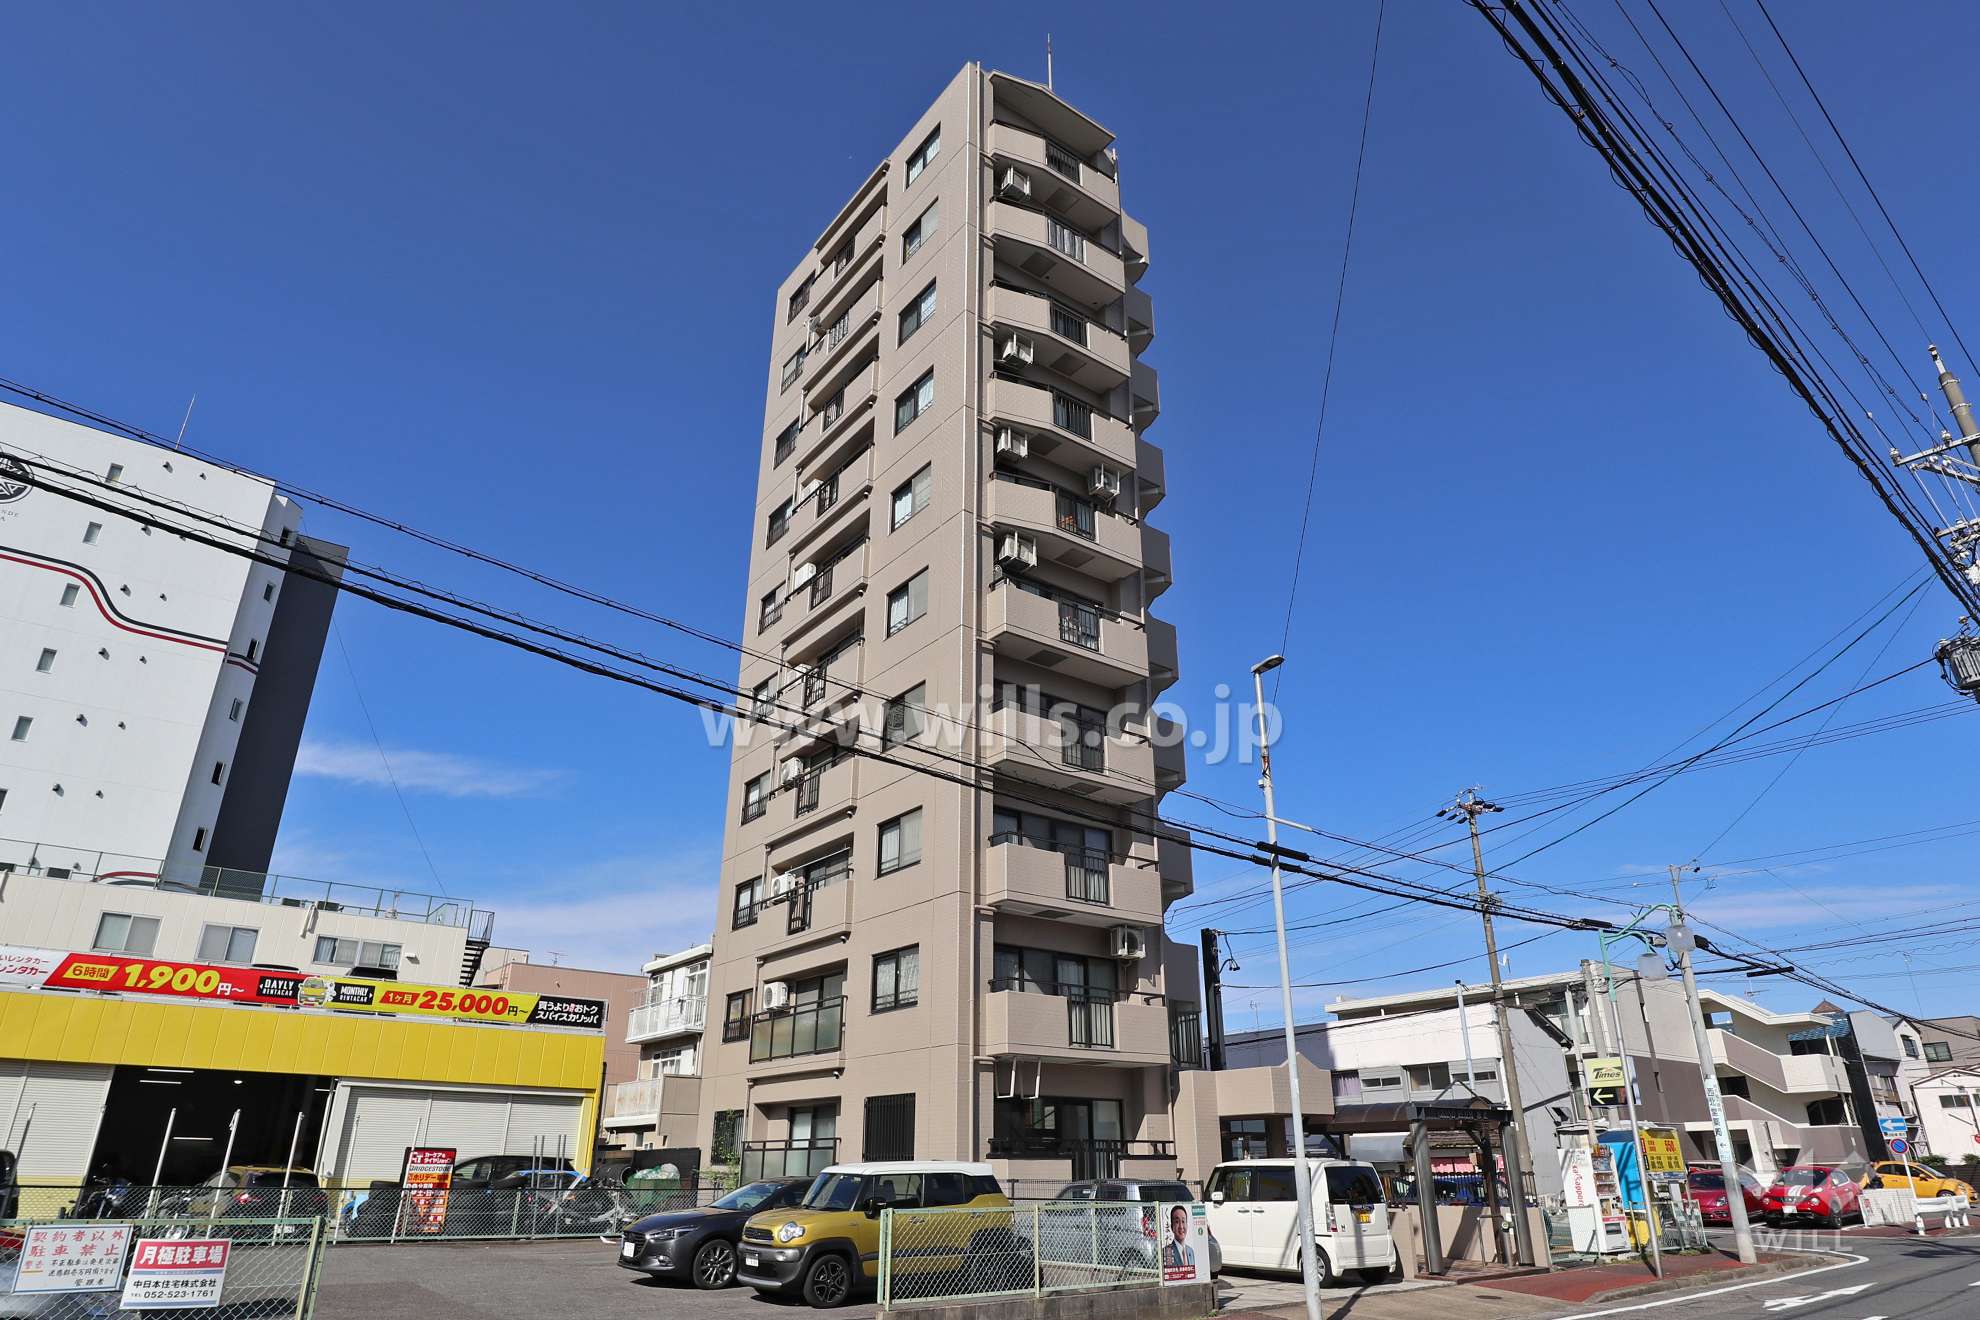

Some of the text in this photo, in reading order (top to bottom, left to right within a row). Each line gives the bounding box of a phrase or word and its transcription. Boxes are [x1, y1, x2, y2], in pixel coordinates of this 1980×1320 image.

[72, 965, 111, 979] 6時間
[264, 979, 295, 990] DAYLY
[340, 985, 369, 996] MONTHLY
[1593, 1066, 1622, 1080] Times
[32, 1230, 124, 1242] 契約者以外
[28, 1243, 120, 1257] 駐車禁止
[140, 1245, 224, 1265] 月極駐車場
[133, 1279, 217, 1289] 中日本住宅株式会社
